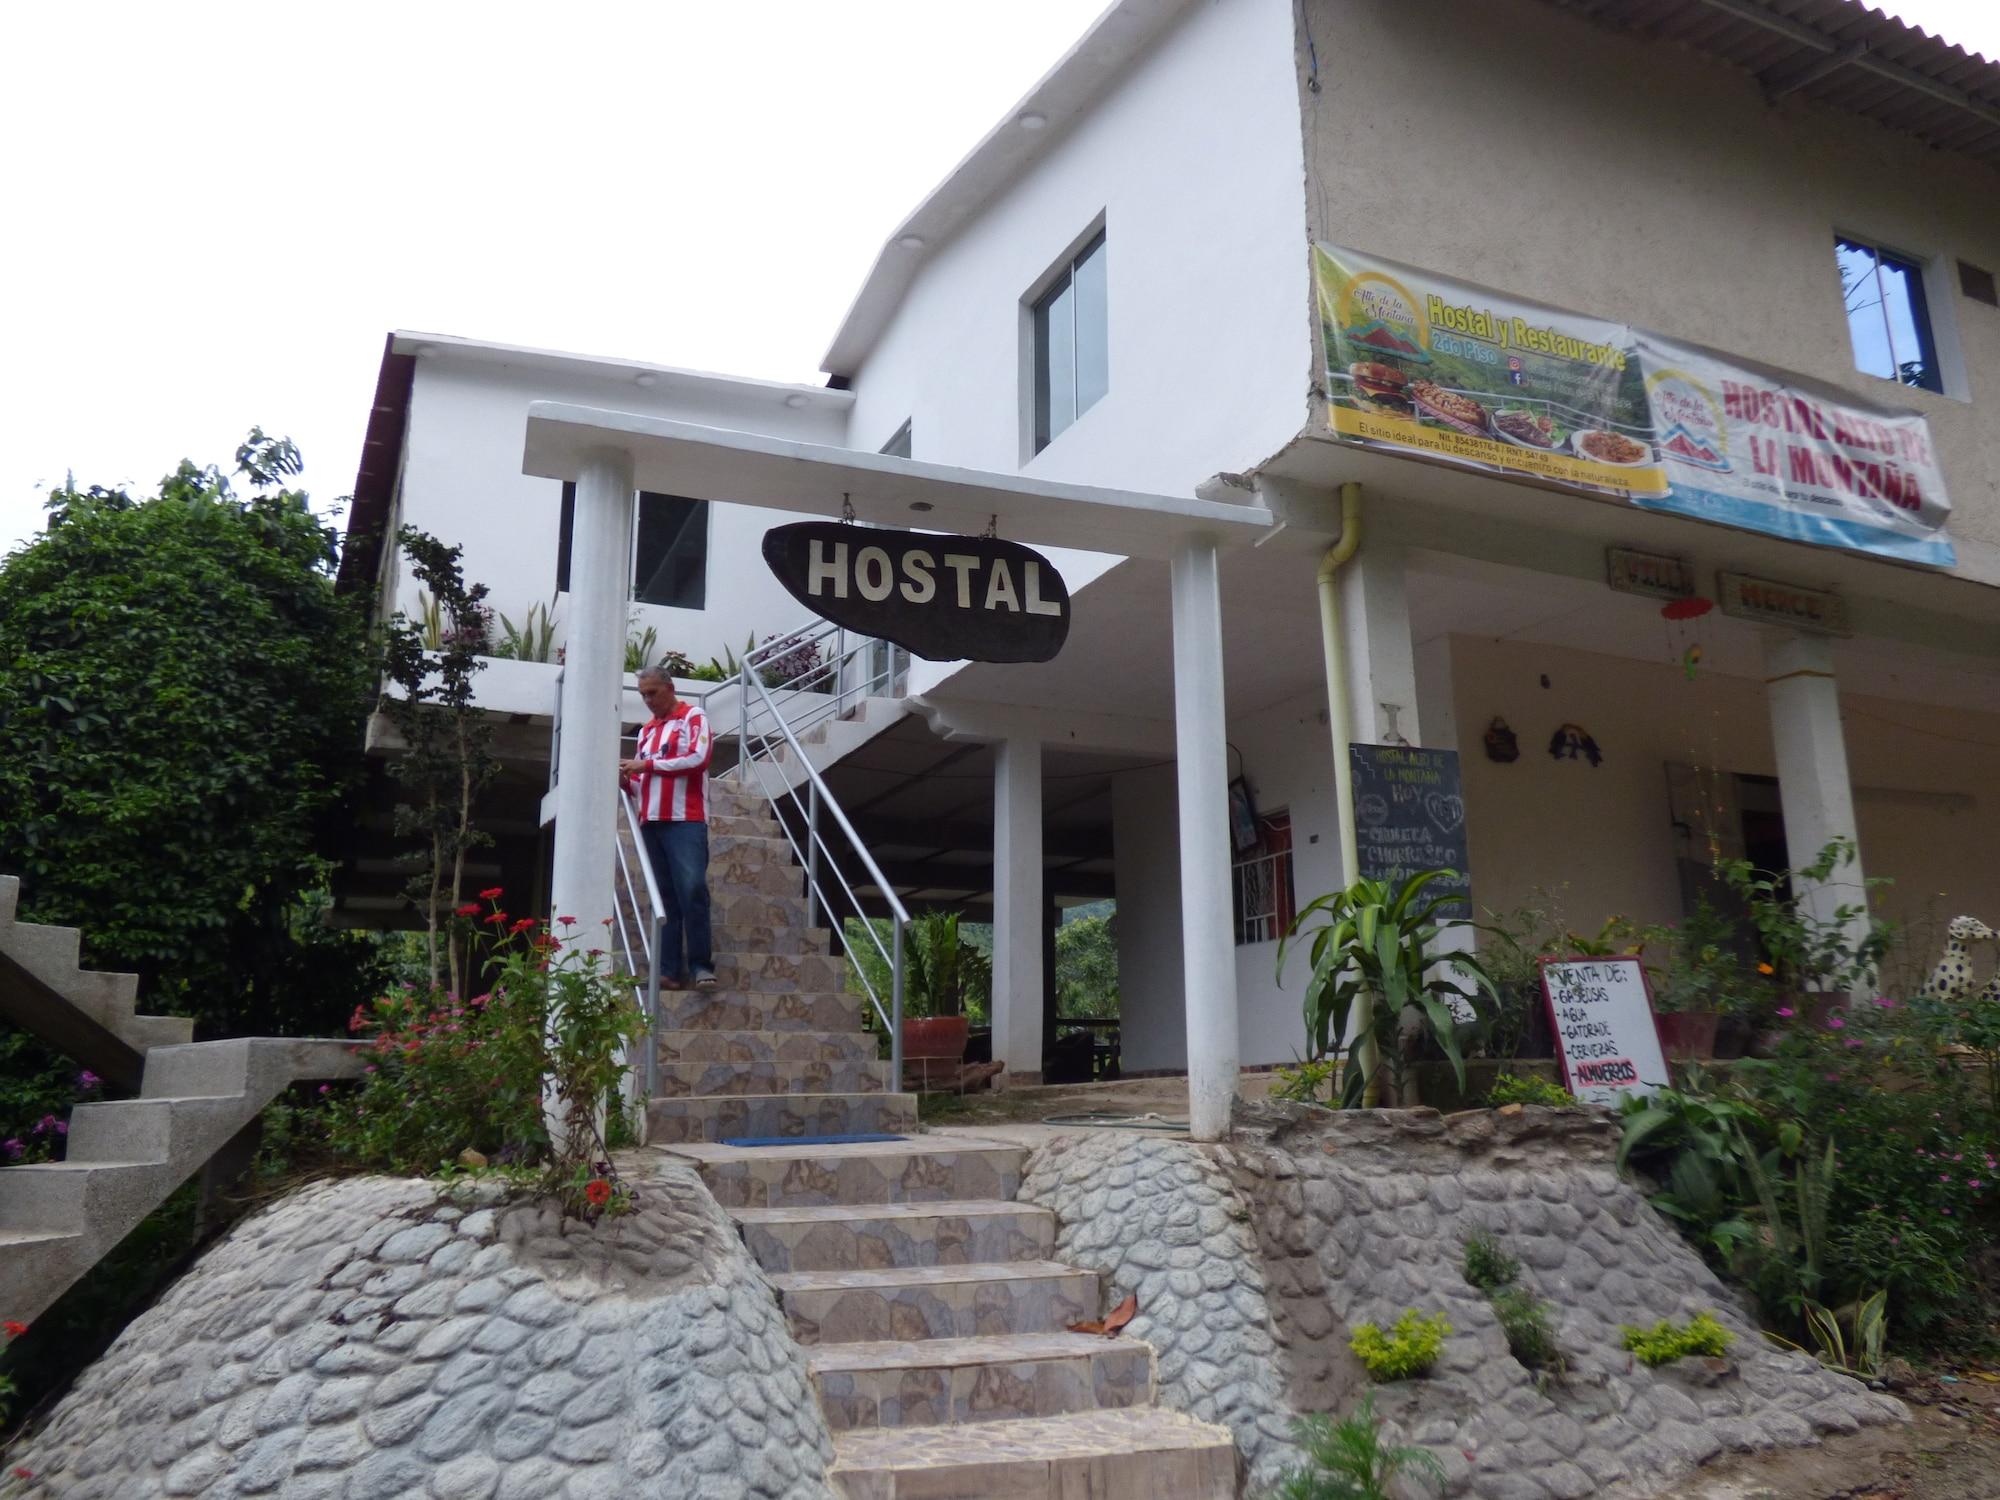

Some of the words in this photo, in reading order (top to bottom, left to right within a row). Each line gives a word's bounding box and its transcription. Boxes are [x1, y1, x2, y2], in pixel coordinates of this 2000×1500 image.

[1427, 294, 1494, 338] Hostal
[1496, 318, 1509, 349] y
[1512, 317, 1626, 372] Restaurante
[1433, 332, 1458, 356] 2do
[1464, 339, 1498, 365] Piso
[1359, 422, 1368, 433] El
[1370, 423, 1391, 439] sitio
[1392, 430, 1416, 445] ideal
[1418, 437, 1440, 450] para
[1441, 442, 1451, 452] tu
[1453, 444, 1497, 461] descanso
[1506, 457, 1552, 473] encuentro
[1553, 466, 1569, 476] con
[1787, 445, 1921, 511] MONTAÑA
[808, 539, 1061, 616] HOSTAL
[1392, 784, 1424, 804] HOY
[1556, 966, 1600, 987] VENTA
[1605, 964, 1628, 984] DE:
